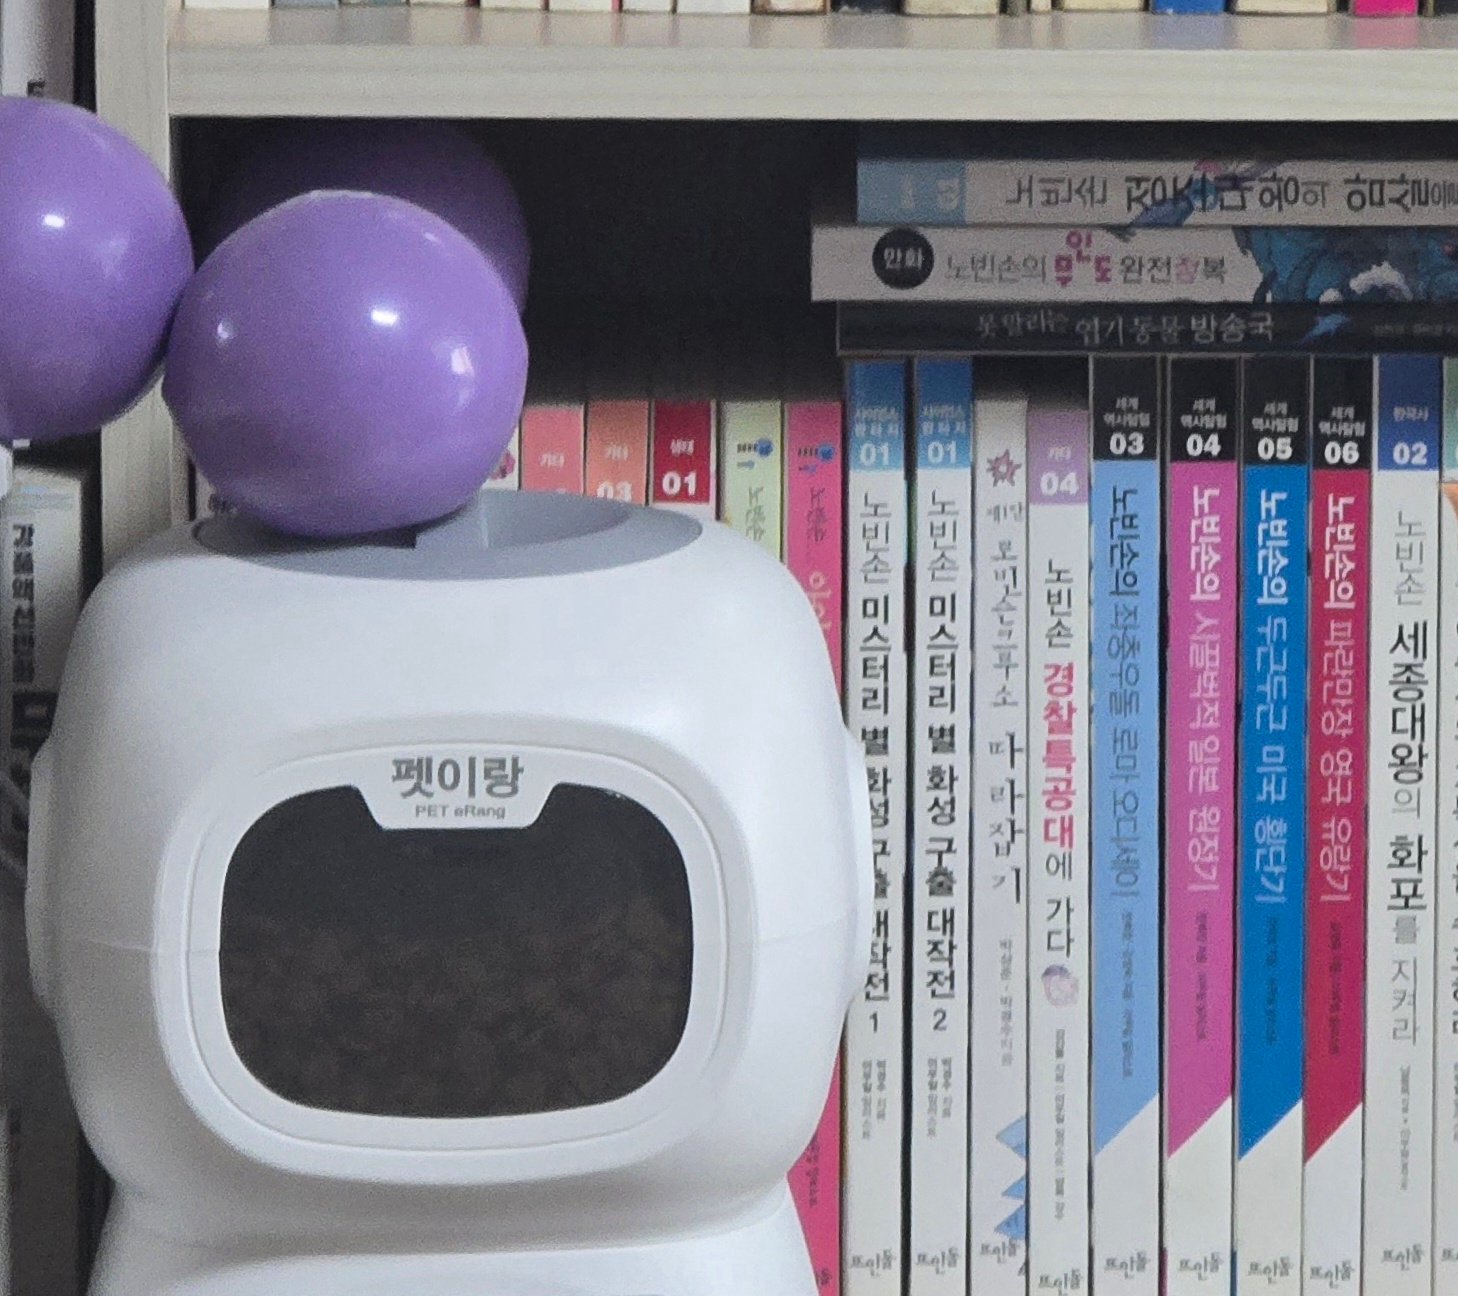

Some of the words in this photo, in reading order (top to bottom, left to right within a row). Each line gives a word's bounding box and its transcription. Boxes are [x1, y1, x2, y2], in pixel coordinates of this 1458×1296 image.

[1004, 174, 1108, 208] 노빈손
[945, 254, 1047, 283] 노빈손의
[1190, 311, 1274, 342] 방송국
[859, 441, 890, 466] 01
[927, 441, 958, 466] 01
[1109, 433, 1144, 455] 03
[1186, 434, 1221, 456] 04
[1257, 437, 1293, 459] 05
[1324, 441, 1359, 463] 06
[1393, 442, 1427, 464] 02
[662, 471, 697, 496] 01
[1040, 474, 1078, 495] 04
[860, 492, 891, 584] 노빈손
[927, 490, 958, 582] 노빈손
[1109, 486, 1141, 597] 노빈손의
[1190, 486, 1220, 601] 노빈손의
[860, 593, 891, 716] 미스터리
[927, 592, 958, 715] 미스터리
[1107, 603, 1141, 718] 좌충우돌
[1189, 610, 1220, 730] 시끌벅적
[1256, 614, 1288, 732] 두근두근
[1321, 618, 1355, 738] 파란만장
[928, 724, 956, 754] 별
[1387, 619, 1428, 820] 세종대왕의
[391, 755, 524, 799] 펫이랑
[1110, 726, 1142, 782] 로마
[1188, 734, 1220, 793] 일본
[1256, 745, 1288, 805] 미국
[1320, 747, 1353, 806] 영국
[415, 804, 449, 819] PET
[926, 764, 957, 826] 화성
[925, 837, 956, 897] 구출
[1110, 787, 1141, 898] 오디세이
[1187, 805, 1220, 893] 원정기
[1254, 816, 1287, 903] 횡단기
[1319, 816, 1352, 903] 유람기
[1387, 835, 1428, 945] 화포를
[926, 906, 957, 1000] 대작전
[1046, 896, 1074, 959] 가다
